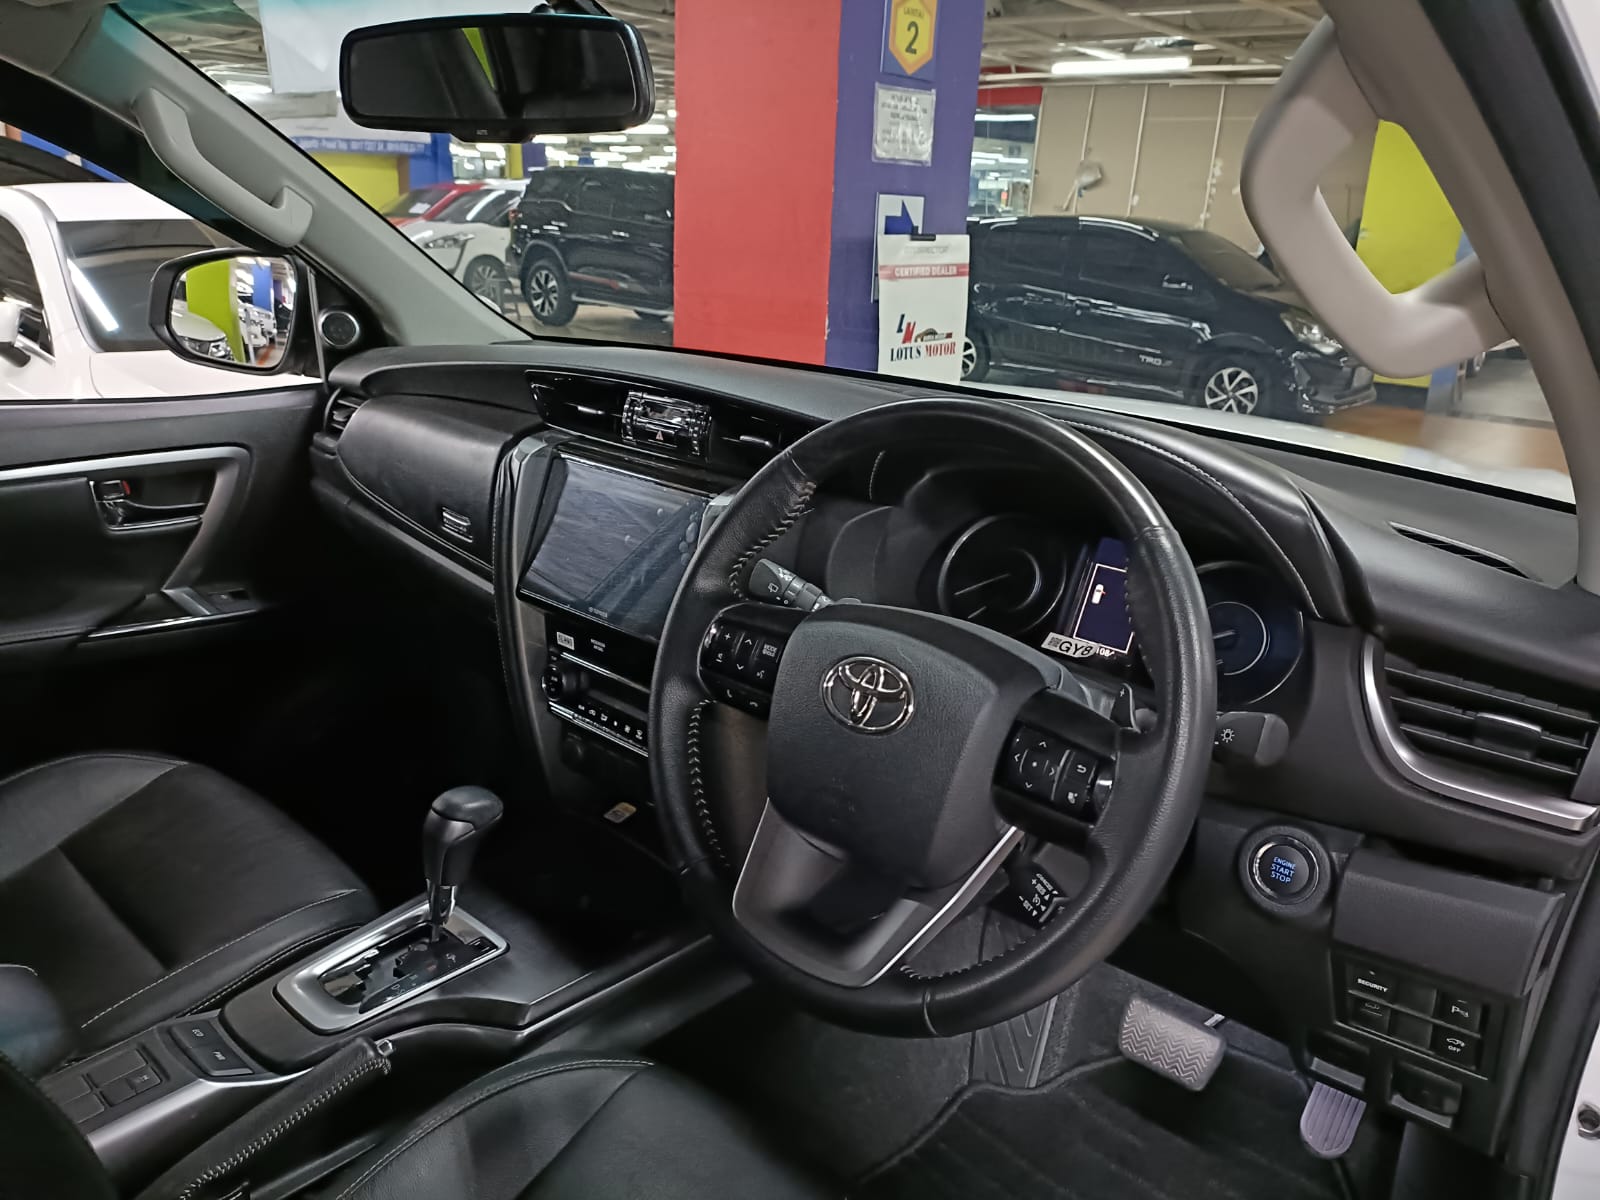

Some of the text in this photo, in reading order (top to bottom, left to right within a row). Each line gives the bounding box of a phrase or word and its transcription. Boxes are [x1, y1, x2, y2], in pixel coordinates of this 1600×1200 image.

[905, 21, 919, 55] 2
[895, 265, 957, 277] CERTIFIED DEALER
[890, 342, 956, 362] LOTUS MOTOR
[1059, 641, 1093, 656] GY8
[1271, 863, 1295, 877] START
[1273, 856, 1296, 870] ENGINE
[1271, 871, 1291, 883] STOP
[1357, 978, 1388, 992] SECURITY
[1447, 1045, 1461, 1053] OFF
